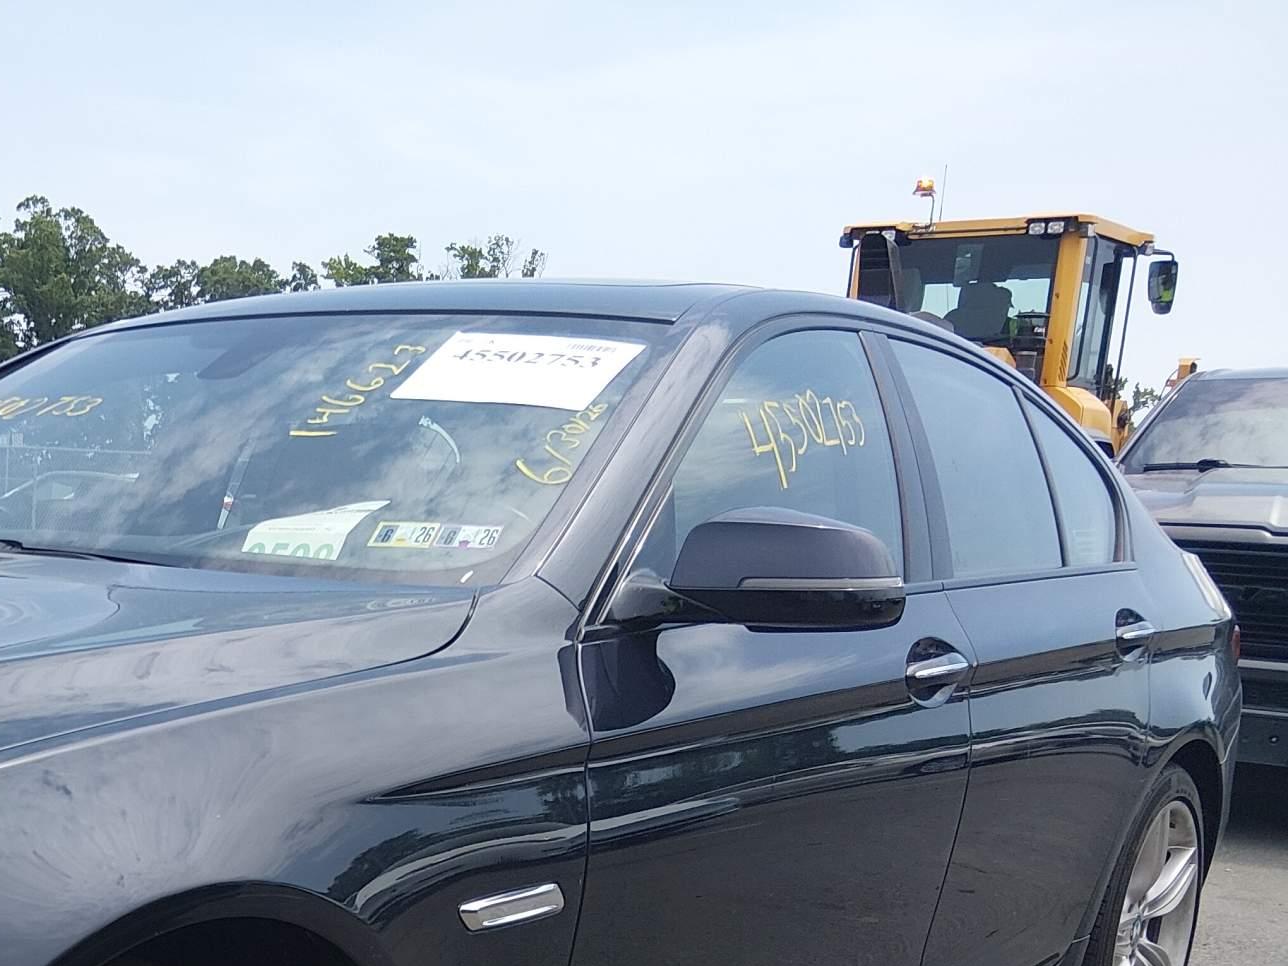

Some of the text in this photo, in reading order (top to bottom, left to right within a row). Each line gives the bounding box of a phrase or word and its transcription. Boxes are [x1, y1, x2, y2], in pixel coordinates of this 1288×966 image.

[452, 348, 602, 369] 45502753
[738, 388, 865, 491] 45502753
[414, 526, 435, 544] 26
[478, 528, 500, 546] 26
